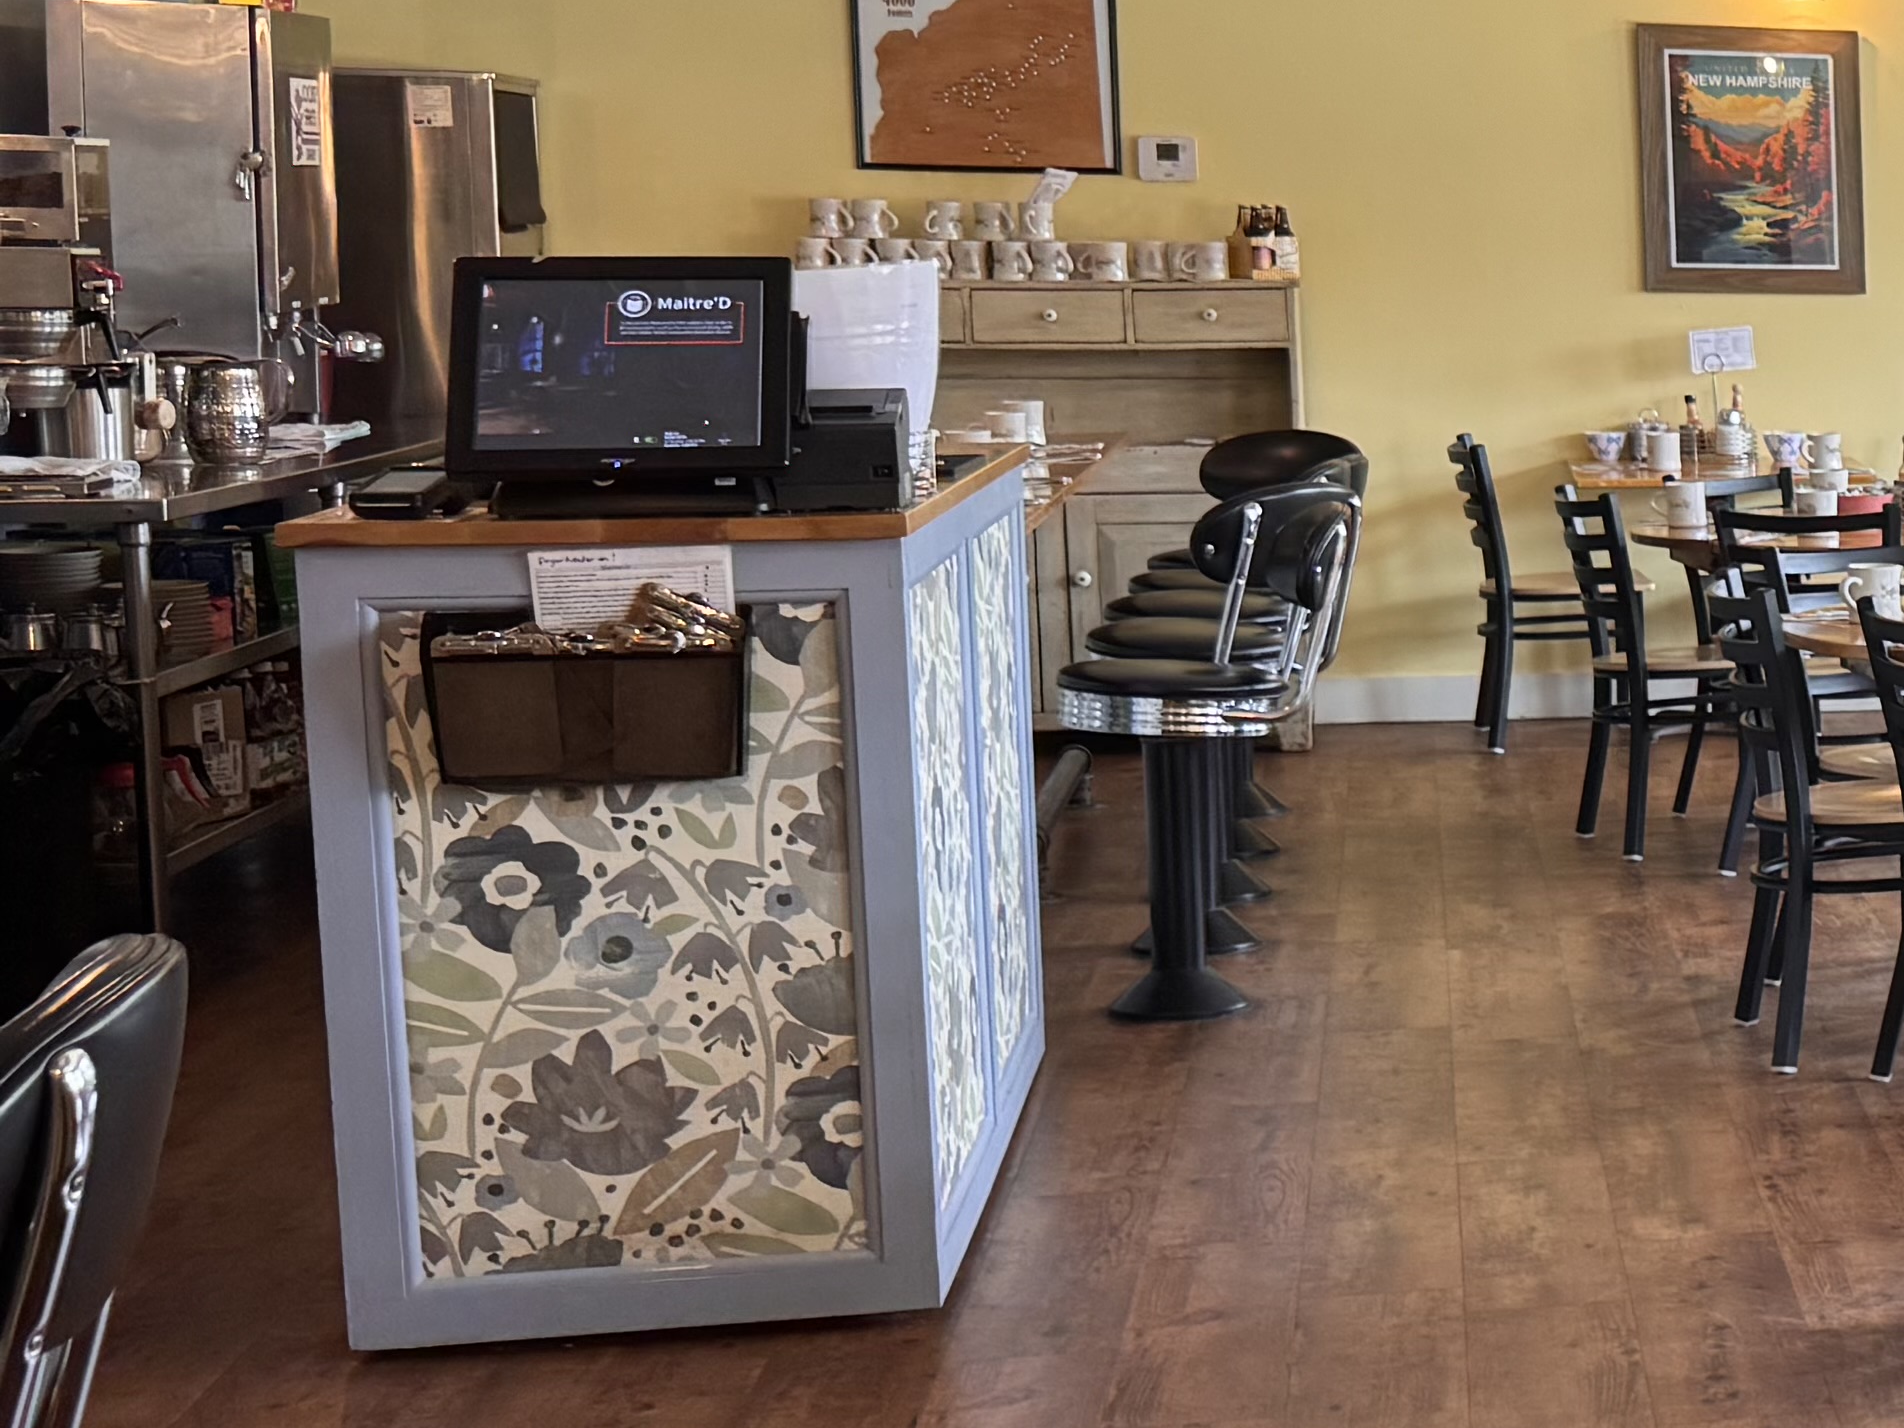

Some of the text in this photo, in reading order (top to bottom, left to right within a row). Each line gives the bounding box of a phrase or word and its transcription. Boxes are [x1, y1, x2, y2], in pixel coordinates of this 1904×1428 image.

[1688, 74, 1813, 89] NEW HAMPSHIRE
[657, 296, 732, 310] Maitre'D
